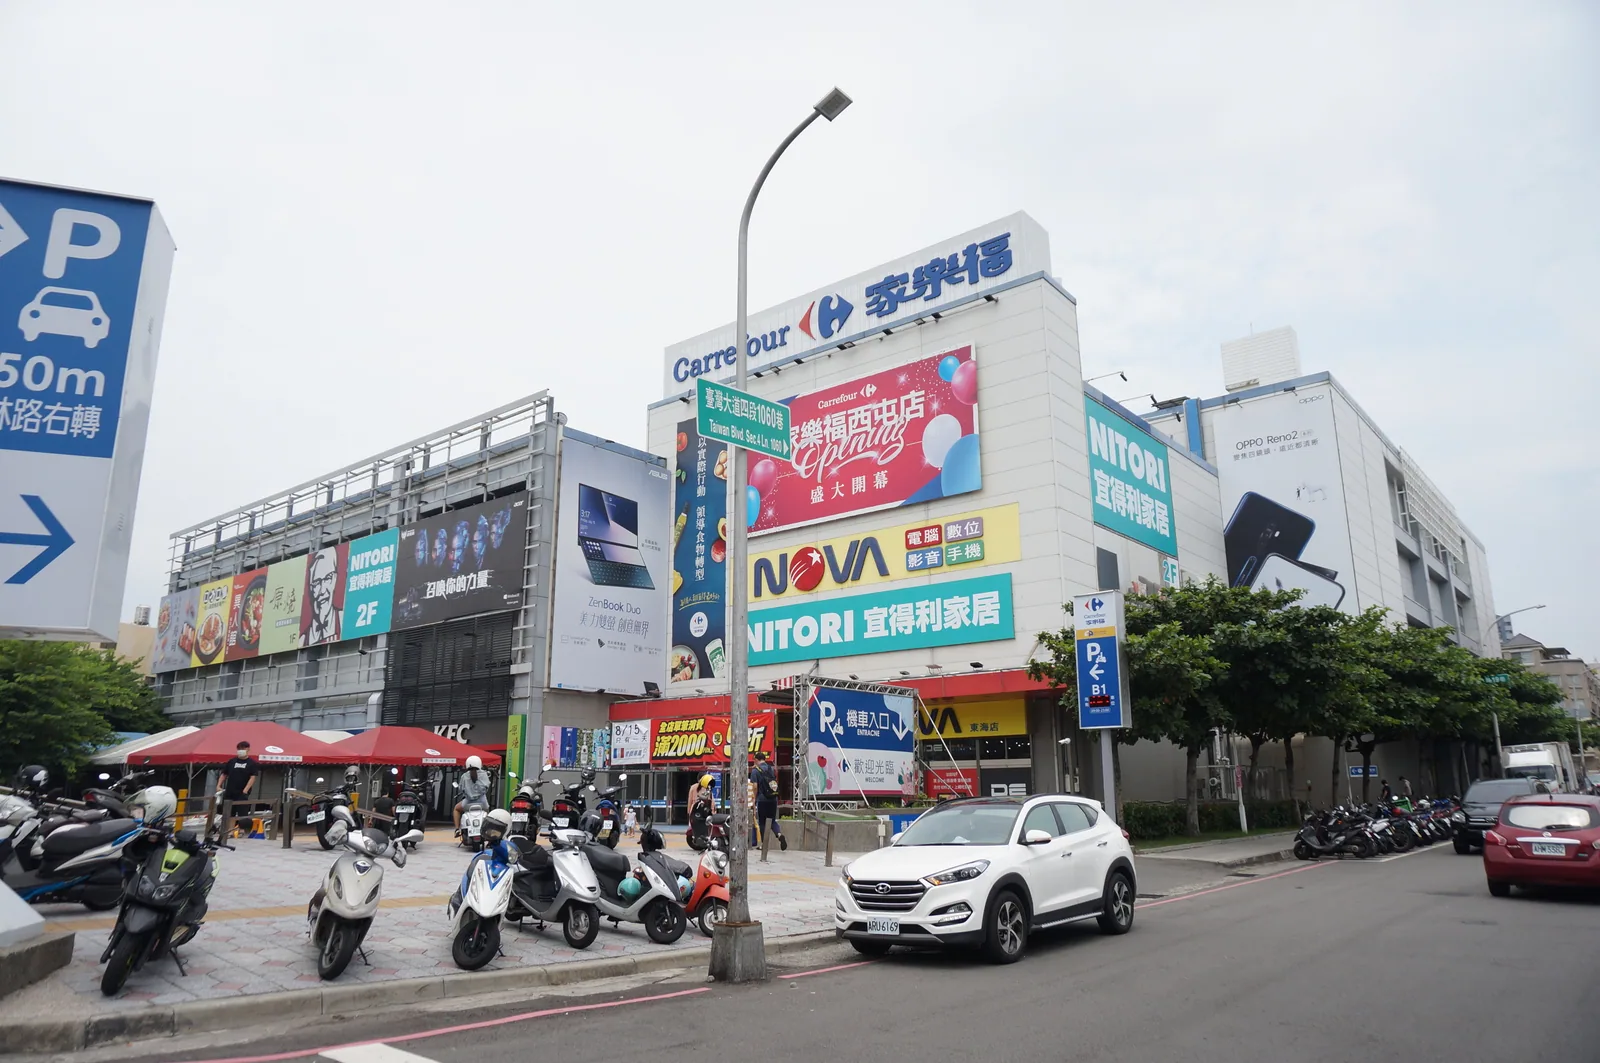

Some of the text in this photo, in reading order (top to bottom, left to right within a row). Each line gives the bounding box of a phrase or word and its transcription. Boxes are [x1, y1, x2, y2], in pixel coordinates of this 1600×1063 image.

[42, 207, 121, 279] P
[865, 232, 1013, 318] 家樂福
[673, 325, 790, 382] Carreour
[705, 387, 784, 430] 臺灣大道四段1060巷
[818, 392, 858, 410] Carrefour
[709, 418, 730, 437] Taiwan
[1235, 437, 1264, 451] OPPO
[1266, 430, 1299, 445] Reno2
[790, 413, 911, 483] Opening
[1088, 415, 1167, 494] NITORI
[811, 470, 889, 504] 盛大開幕
[1093, 468, 1170, 538] 宜得利家居
[907, 527, 939, 546] 電腦
[946, 520, 981, 540] 數位
[350, 544, 395, 572] NITORI
[907, 550, 940, 568] 影音
[946, 542, 981, 562] 手機
[348, 565, 393, 593] 宜得利家居
[753, 536, 890, 598] NOVA
[1163, 559, 1177, 584] 2F
[425, 569, 491, 600] 召喚你的力量
[355, 600, 379, 628] 2F
[588, 596, 642, 615] ZenBook Duo
[863, 590, 1000, 640] 宜得利家居
[748, 609, 855, 653] NITORI
[1086, 642, 1101, 662] P
[1091, 683, 1106, 696] B1
[615, 724, 640, 737] 8/15
[821, 701, 836, 733] P
[846, 708, 890, 730] 機車入口
[970, 722, 999, 733] 東海店
[854, 759, 895, 775] 歡迎光臨
